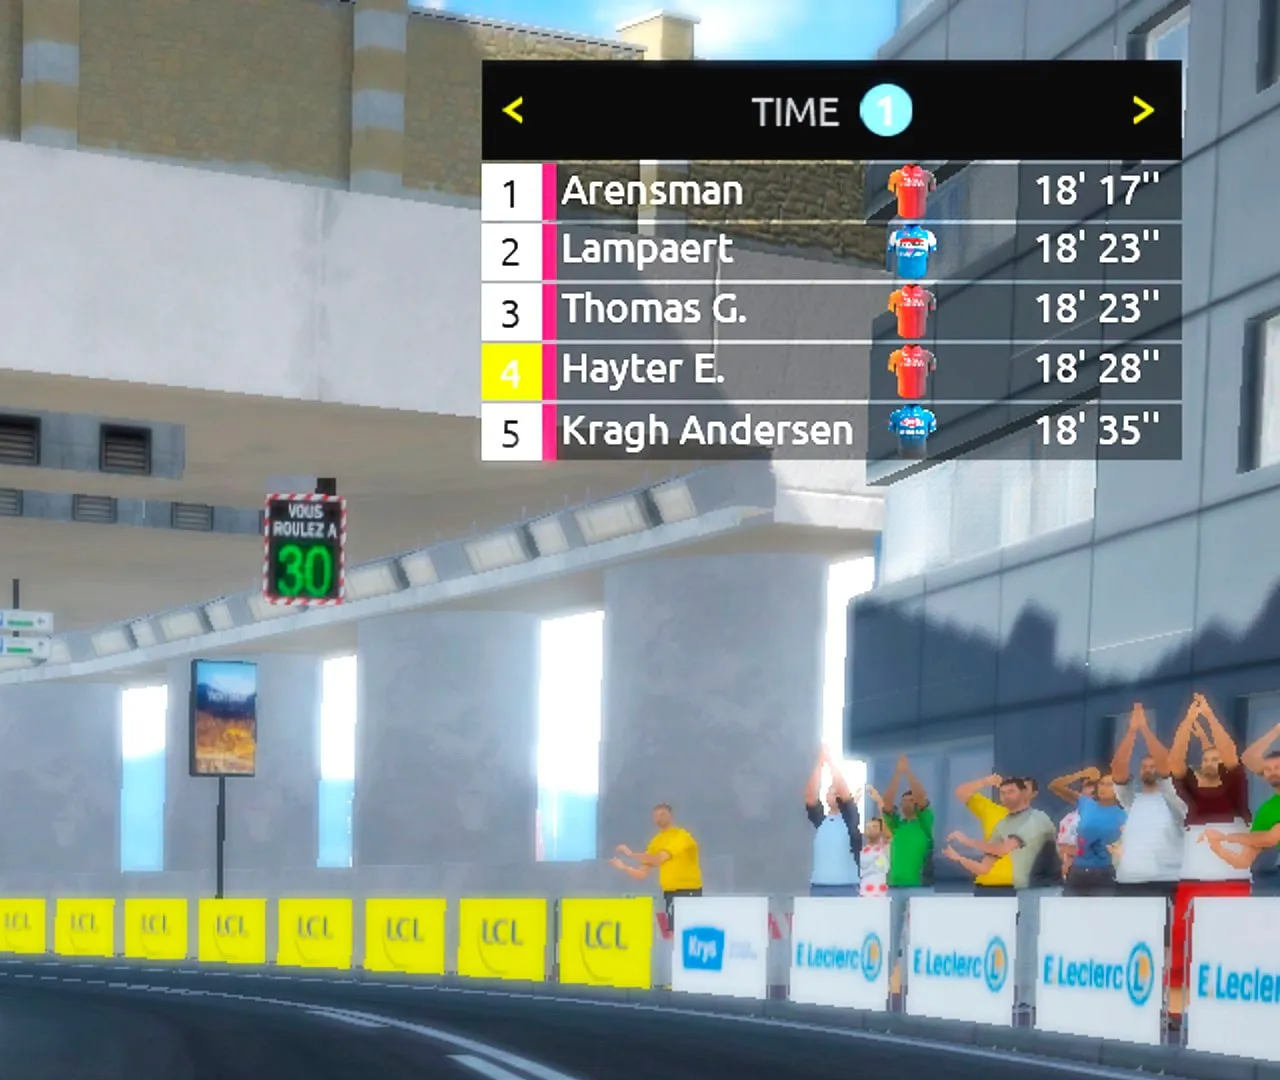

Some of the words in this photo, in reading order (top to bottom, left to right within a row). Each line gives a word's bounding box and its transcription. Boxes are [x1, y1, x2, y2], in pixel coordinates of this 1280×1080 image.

[288, 503, 324, 519] VOUS
[273, 521, 325, 538] ROULEZ
[327, 522, 338, 539] A
[278, 544, 332, 597] 30
[71, 913, 98, 933] LCL
[142, 914, 170, 934] LCL
[216, 914, 248, 937] LCL
[298, 916, 333, 938] LCL
[387, 917, 423, 942] LCL
[482, 918, 523, 945] LCL
[584, 920, 628, 949] LCL
